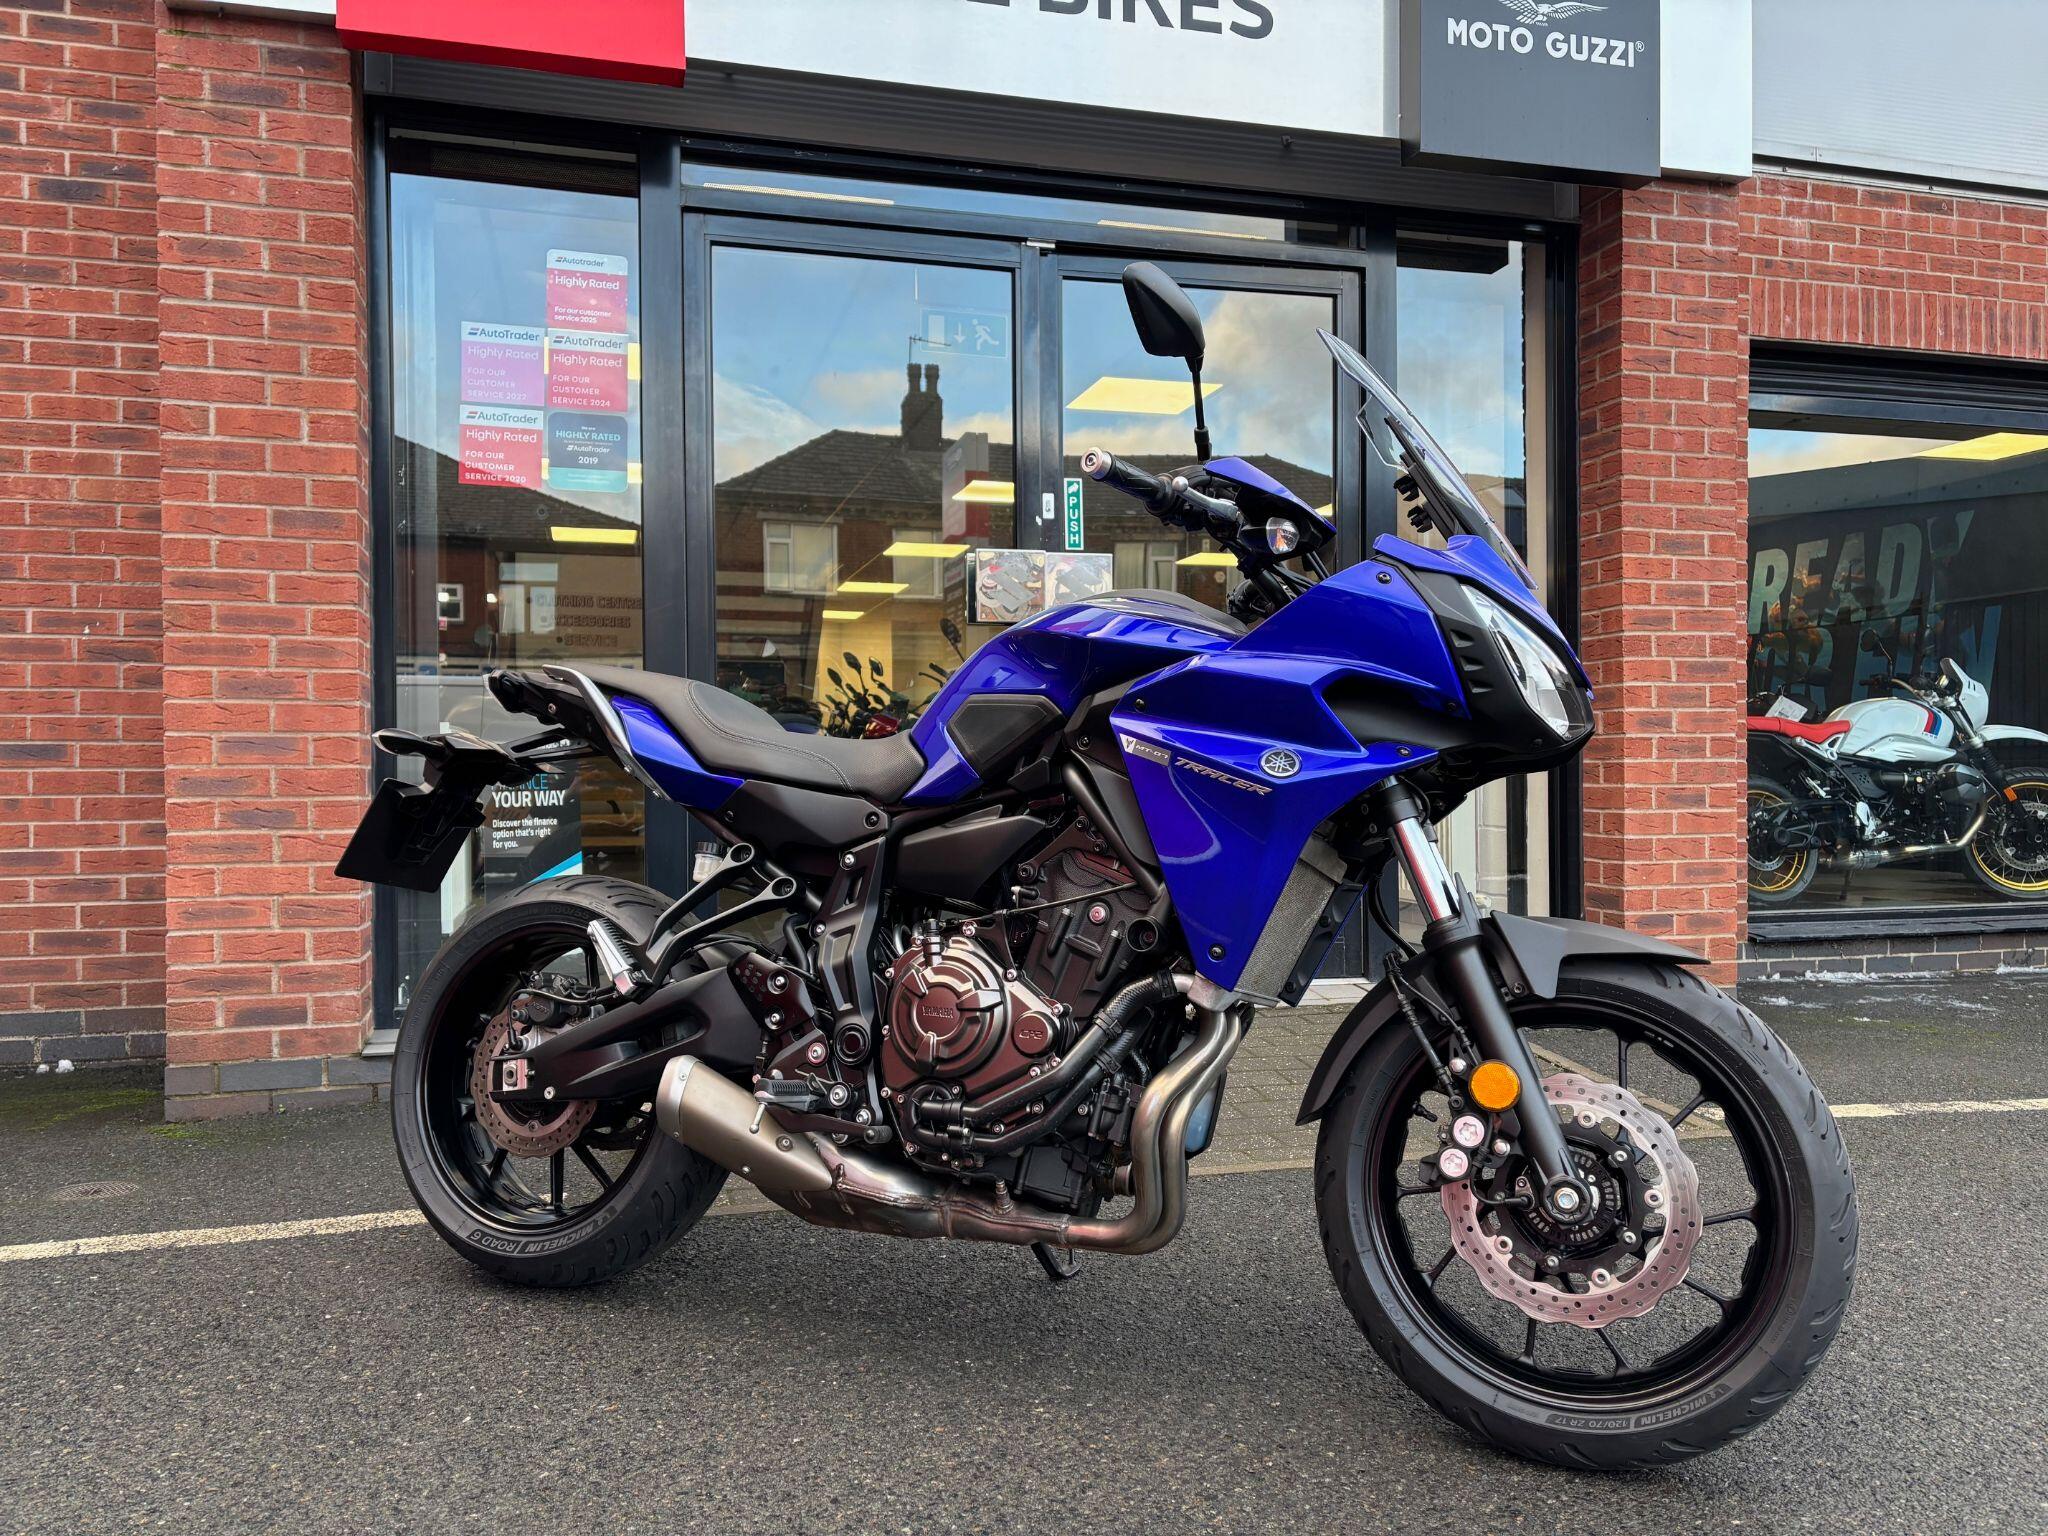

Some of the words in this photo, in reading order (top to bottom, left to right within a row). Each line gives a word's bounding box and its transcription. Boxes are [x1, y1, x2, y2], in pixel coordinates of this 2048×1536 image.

[1447, 17, 1534, 54] MOTO
[555, 275, 588, 288] Highly
[589, 279, 620, 290] Rated
[554, 314, 579, 322] service
[579, 308, 612, 317] customer
[479, 328, 540, 341] AutoTrader
[564, 336, 623, 349] AutoTrader
[467, 345, 503, 359] Highly
[505, 349, 539, 360] Rated
[553, 353, 588, 366] Highly
[589, 356, 622, 367] Rated
[467, 366, 485, 375] FOR
[487, 368, 506, 376] OUR
[467, 379, 516, 388] CUSTOMER
[552, 374, 570, 382] FOR
[571, 376, 590, 384] OUR
[467, 389, 504, 399] SERVICE
[552, 385, 600, 395] CUSTOMER
[552, 396, 588, 405] SERVICE
[590, 399, 610, 407] 2024
[477, 411, 538, 424] AutoTrader
[466, 428, 501, 442] Highly
[503, 432, 537, 443] Rated
[555, 430, 590, 439] HIGHLY
[591, 432, 621, 441] RATED
[574, 444, 610, 453] AutoTrader
[465, 450, 483, 458] FOR
[485, 451, 505, 459] OUR
[465, 461, 515, 471] CUSTOMER
[578, 456, 599, 465] 2019
[465, 472, 502, 481] SERVICE
[505, 475, 527, 483] 2020
[1069, 496, 1079, 544] PUSH
[564, 633, 618, 647] SERVICE
[1135, 743, 1169, 760] MT-07
[1174, 756, 1273, 796] TRACER
[492, 790, 532, 808] YOUR
[534, 789, 566, 807] WAY
[492, 819, 520, 828] Discover
[521, 818, 533, 827] the
[534, 817, 558, 826] finance
[492, 828, 514, 840] option
[515, 827, 534, 837] that's
[535, 826, 551, 838] right
[493, 839, 503, 849] for
[503, 840, 519, 850] you.
[470, 1231, 481, 1240] 6
[525, 1224, 594, 1252] MICHELIN
[481, 1234, 517, 1251] ROAD
[1640, 1396, 1707, 1426] MICHELIN
[1570, 1419, 1585, 1427] ZR
[1589, 1418, 1628, 1429] 120/70
